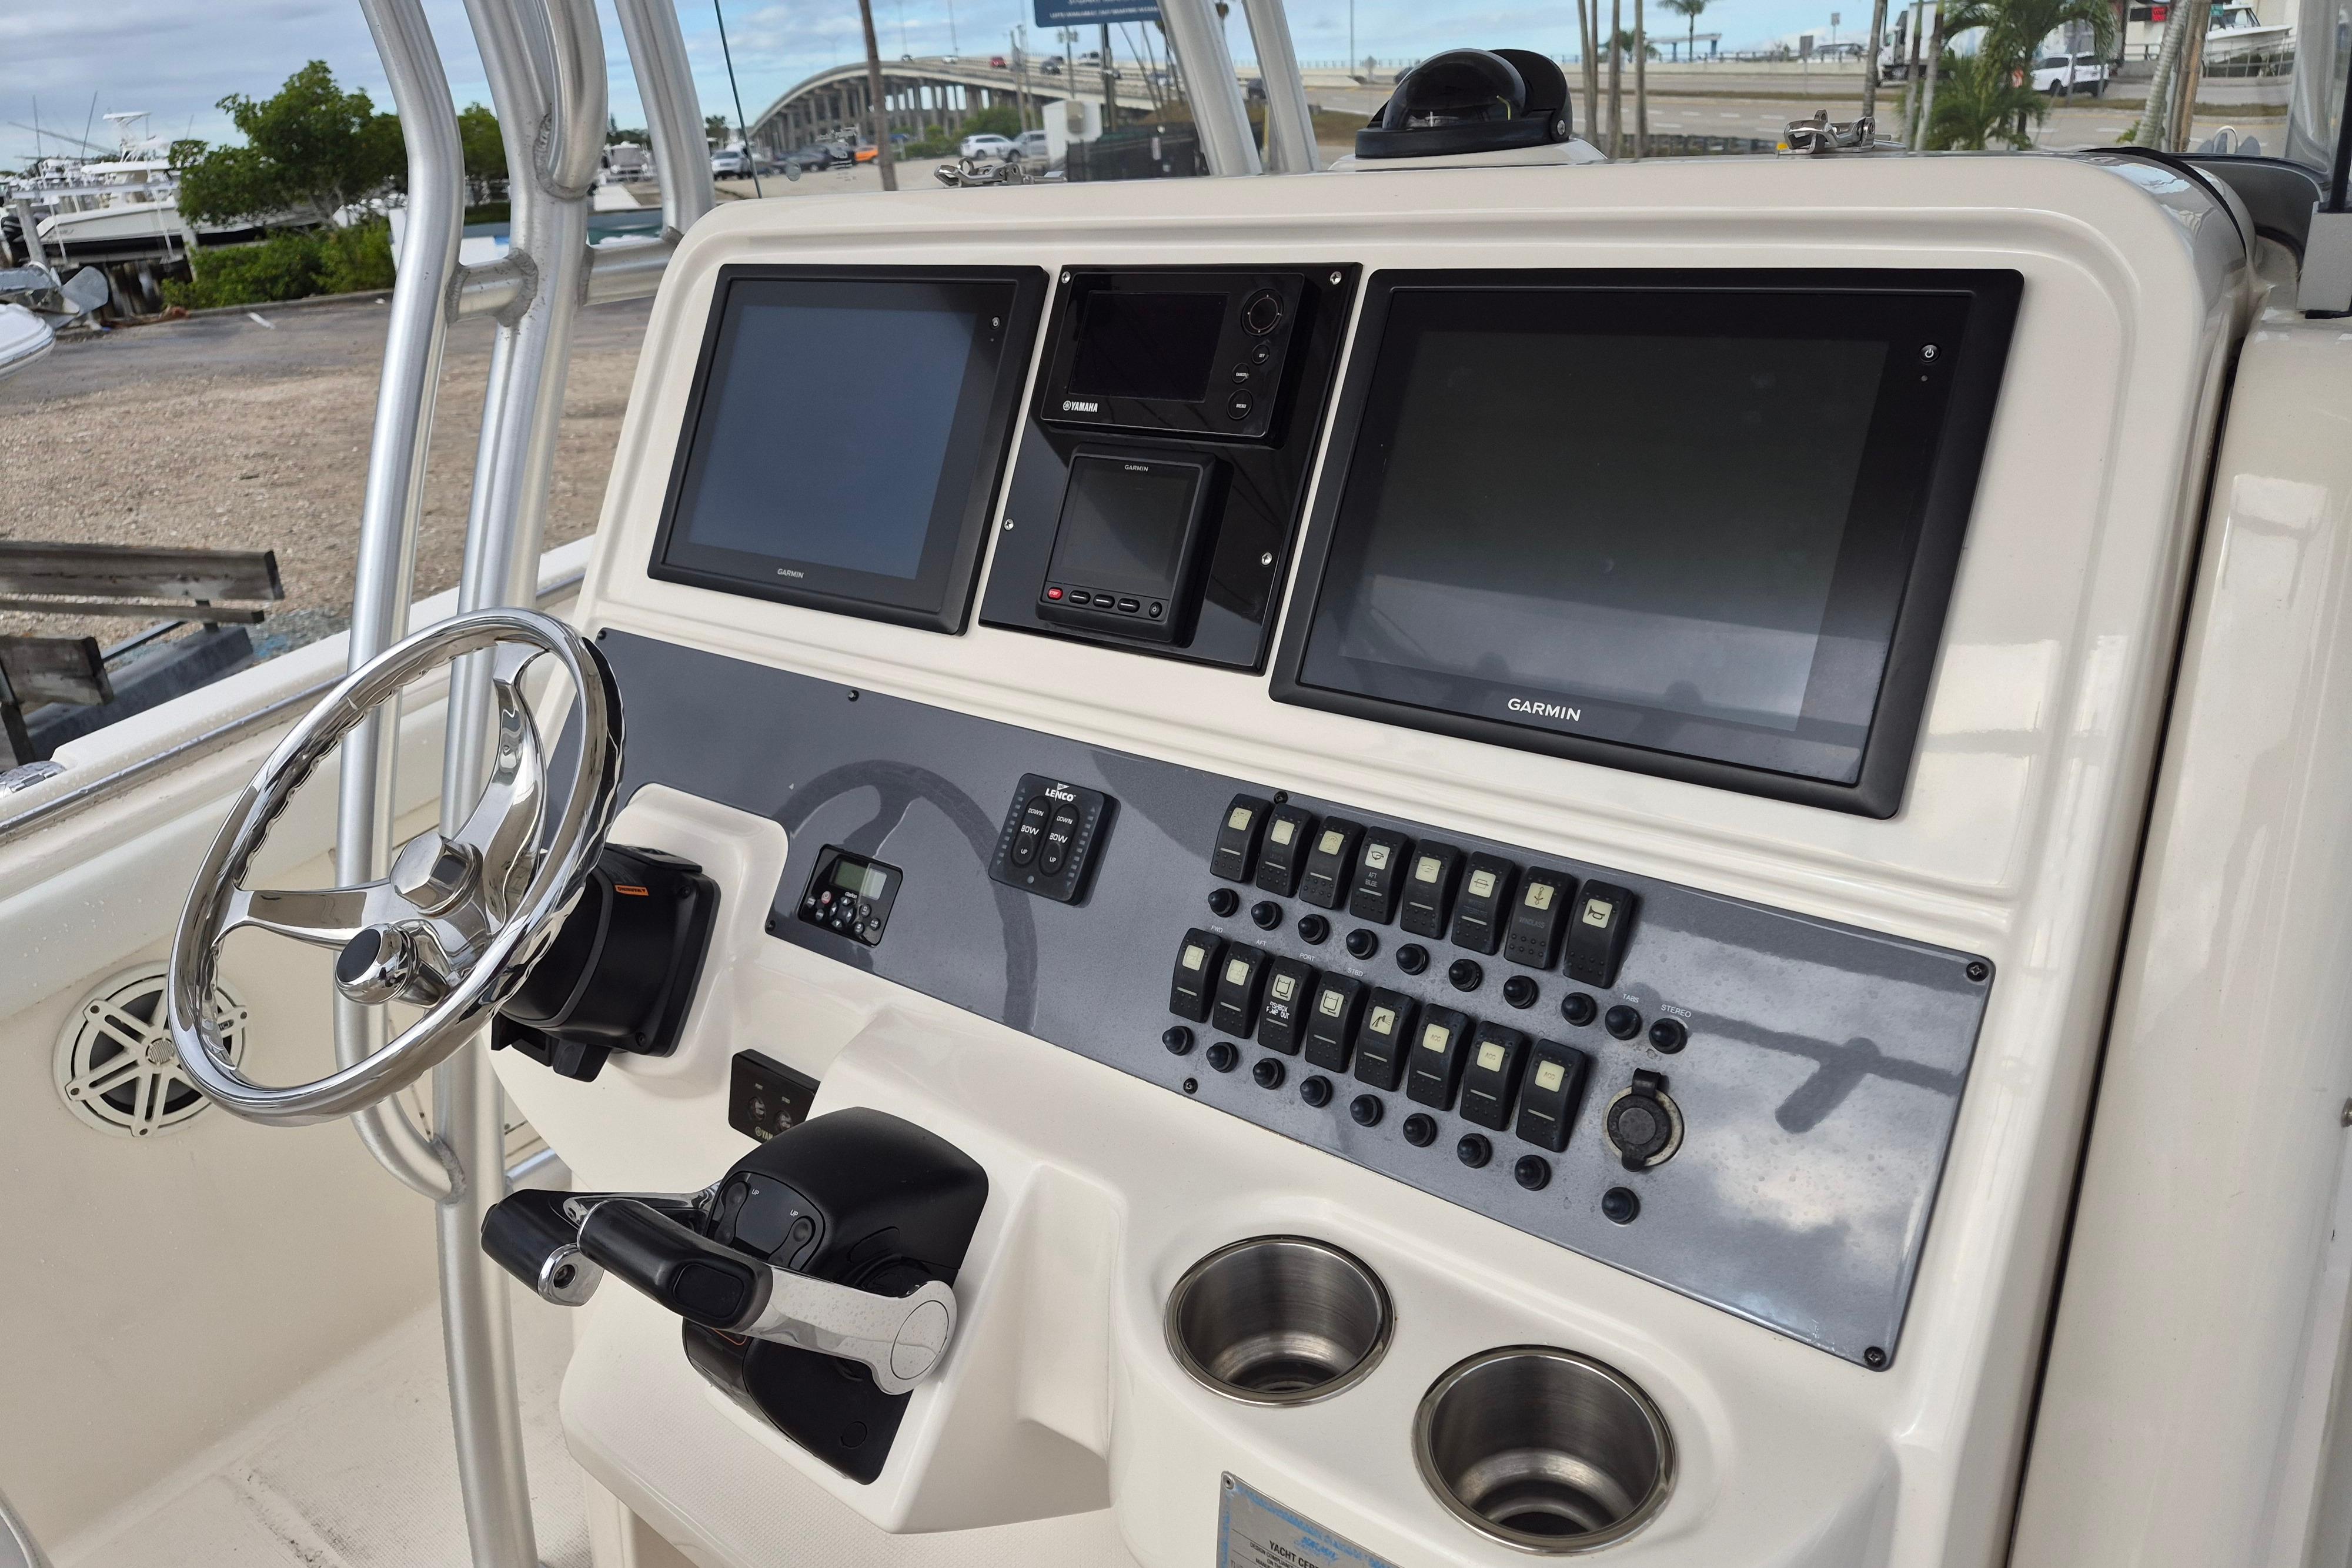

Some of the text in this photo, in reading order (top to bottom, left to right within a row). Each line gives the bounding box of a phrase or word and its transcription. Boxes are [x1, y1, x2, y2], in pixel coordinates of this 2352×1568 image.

[1071, 401, 1098, 413] YAMAHA
[777, 568, 804, 579] GARMIN
[1507, 697, 1582, 722] GARMIN
[1044, 787, 1074, 803] LENCO
[1028, 807, 1044, 817] DOWN
[1056, 815, 1073, 825] DOWN
[1021, 824, 1040, 835] BOW
[1049, 833, 1068, 844] BOW
[1211, 925, 1224, 934] FWD
[1255, 939, 1267, 947] AFT
[1299, 952, 1315, 962] PORT
[1347, 967, 1364, 978] STBD
[1623, 993, 1640, 1004] TABS
[1280, 1011, 1291, 1019] OUT
[1661, 1004, 1692, 1018] STEREO
[790, 1209, 799, 1217] UP
[1269, 1539, 1297, 1563] YACHT
